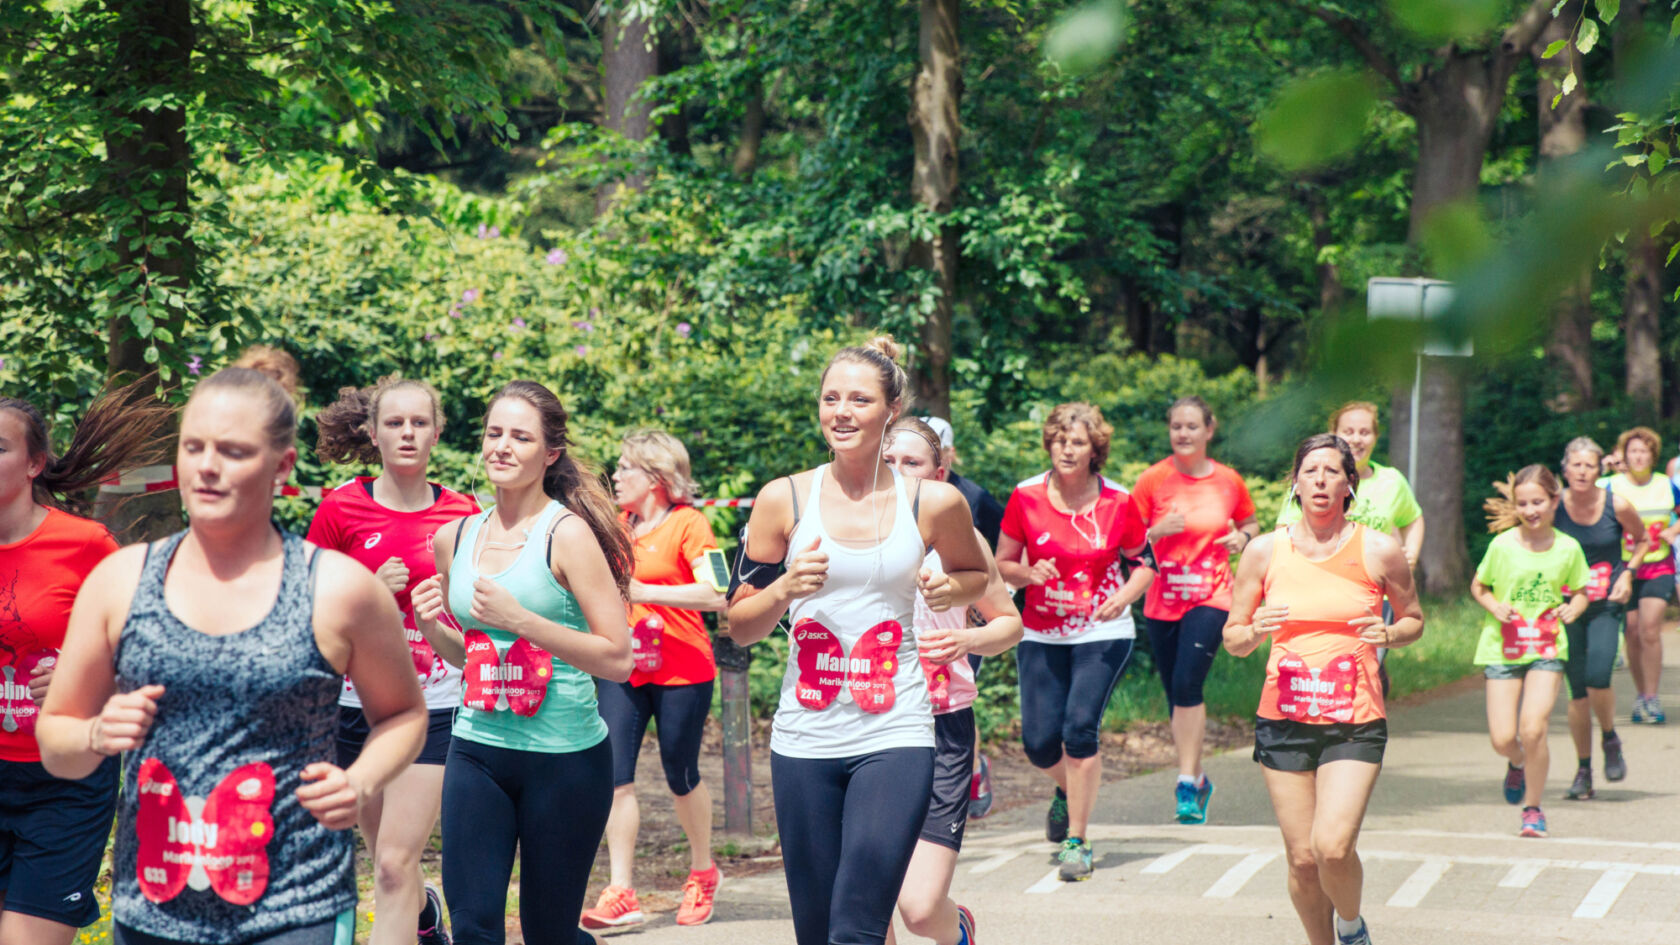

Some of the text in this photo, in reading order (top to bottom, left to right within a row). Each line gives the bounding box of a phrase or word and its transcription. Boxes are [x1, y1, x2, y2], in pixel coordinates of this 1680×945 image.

[480, 662, 523, 683] Marijn
[816, 653, 871, 674] Manon
[800, 689, 822, 700] 2279
[1290, 677, 1336, 695] Shirley
[167, 816, 218, 849] Jody
[144, 866, 168, 884] 633
